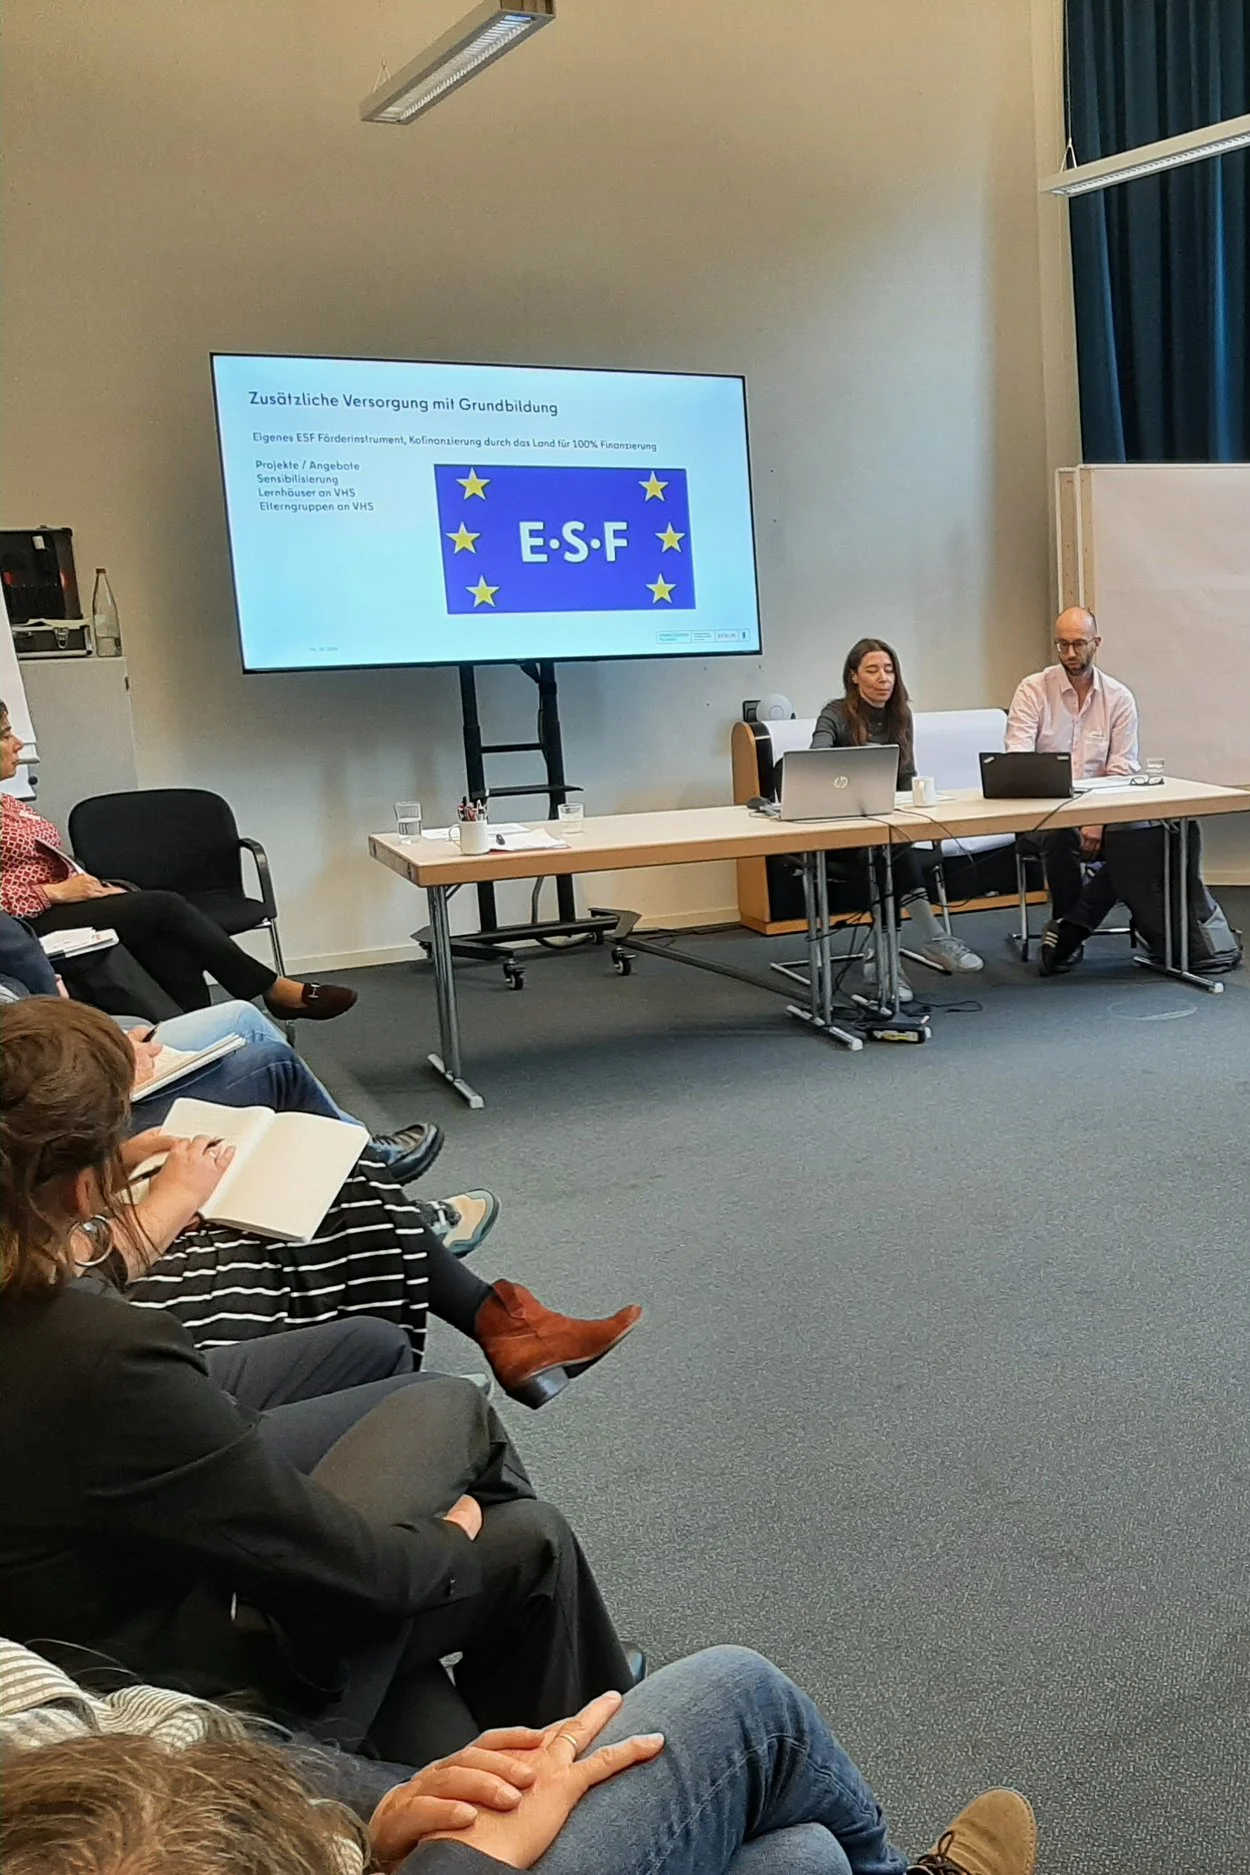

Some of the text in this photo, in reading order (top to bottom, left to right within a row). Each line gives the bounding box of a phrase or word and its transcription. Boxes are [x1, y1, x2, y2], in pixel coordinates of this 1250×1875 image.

[248, 391, 558, 416] Zusätzliche Versorgung mit Grundbildung
[253, 432, 657, 453] Eigenes ESF Förderinstrument, Kofinanzierung durch das Land für 100% Finanzierung
[255, 460, 299, 471] Projekte
[309, 460, 360, 472] Angebote
[257, 473, 339, 486] Sensibilisierung
[258, 487, 356, 498] Lernhäuser an VHS
[260, 501, 374, 513] Elterngruppen an VHS
